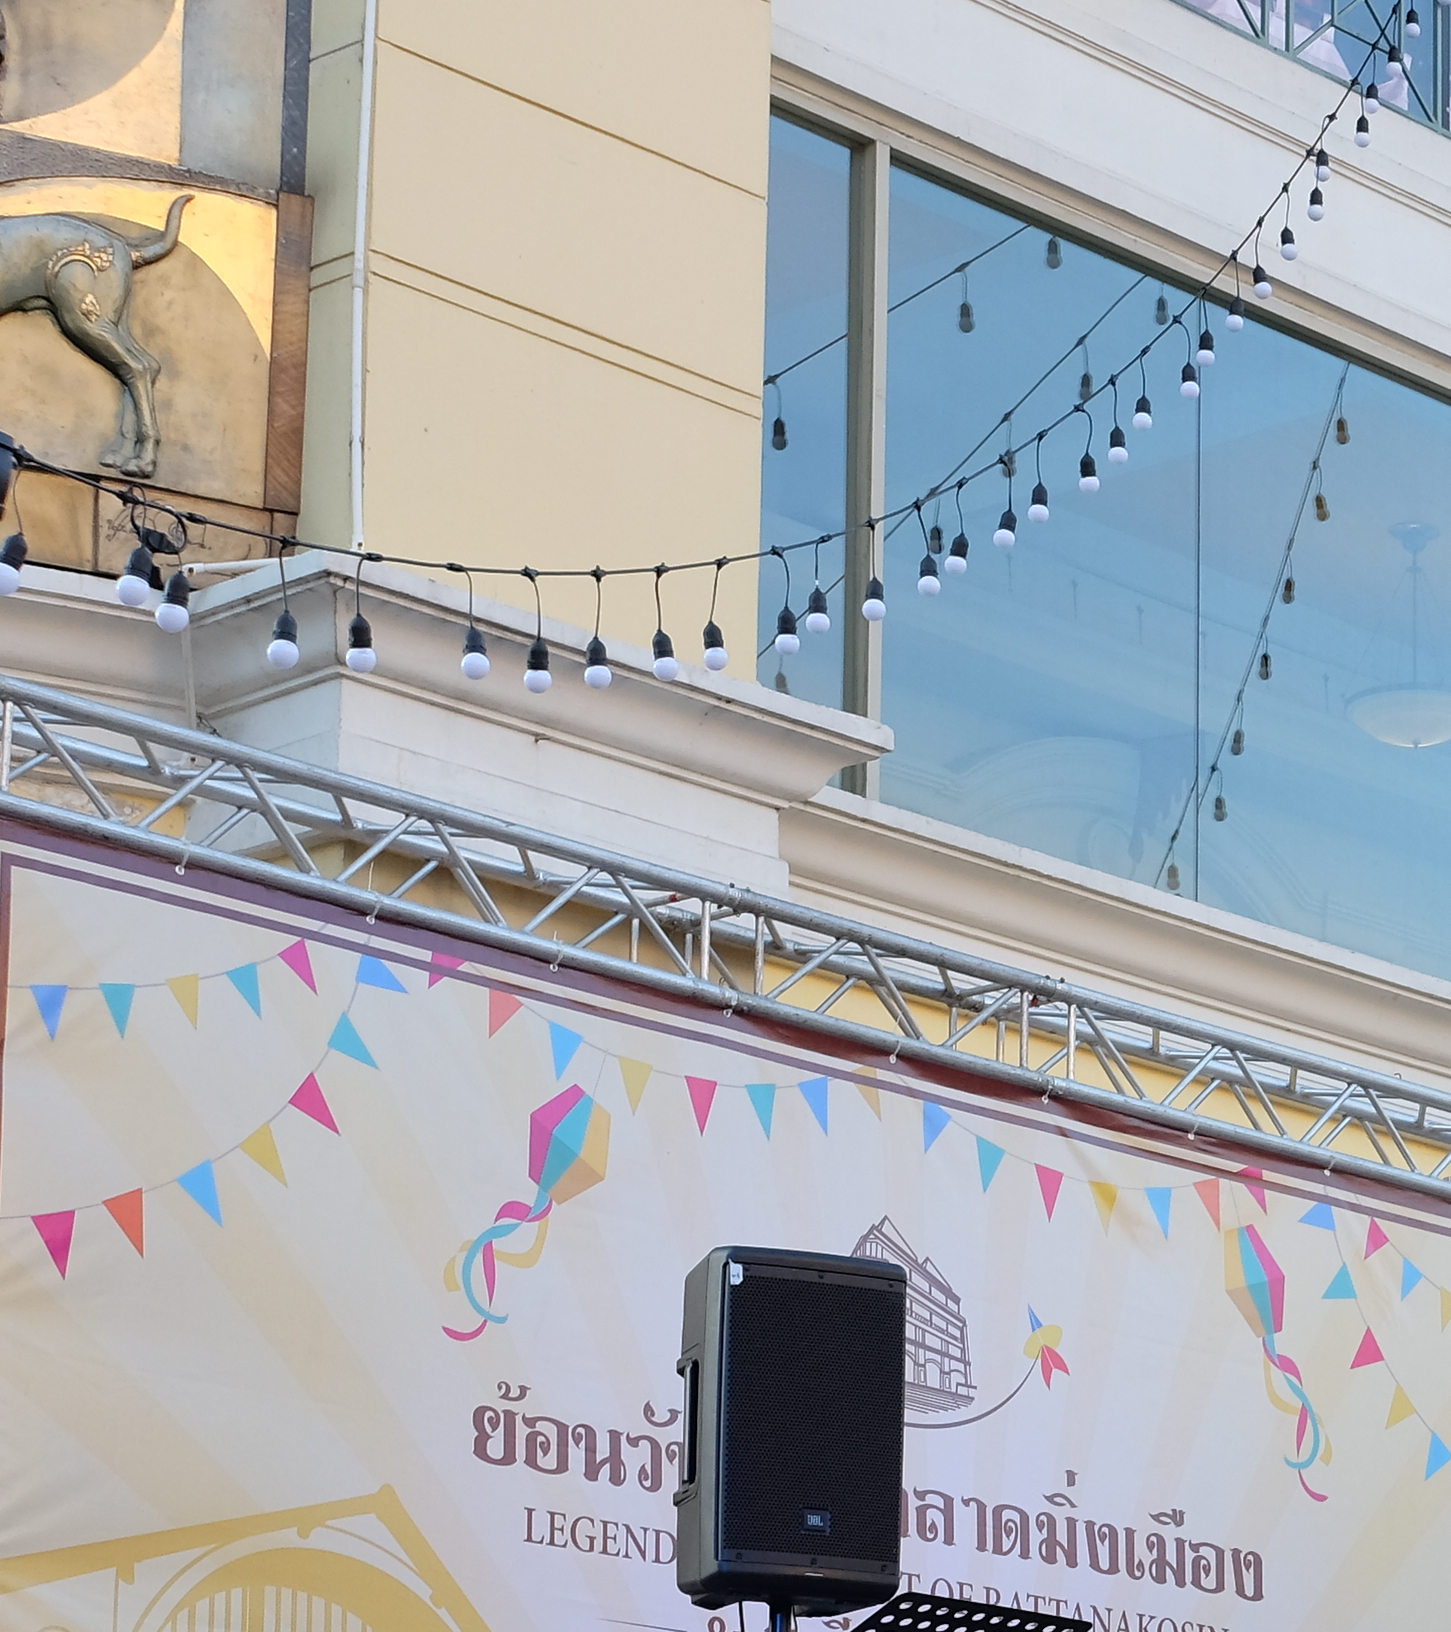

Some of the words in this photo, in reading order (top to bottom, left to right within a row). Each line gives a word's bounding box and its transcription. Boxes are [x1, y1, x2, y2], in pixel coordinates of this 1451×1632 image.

[900, 1469, 1266, 1603] ลาดมิ่งเมือง
